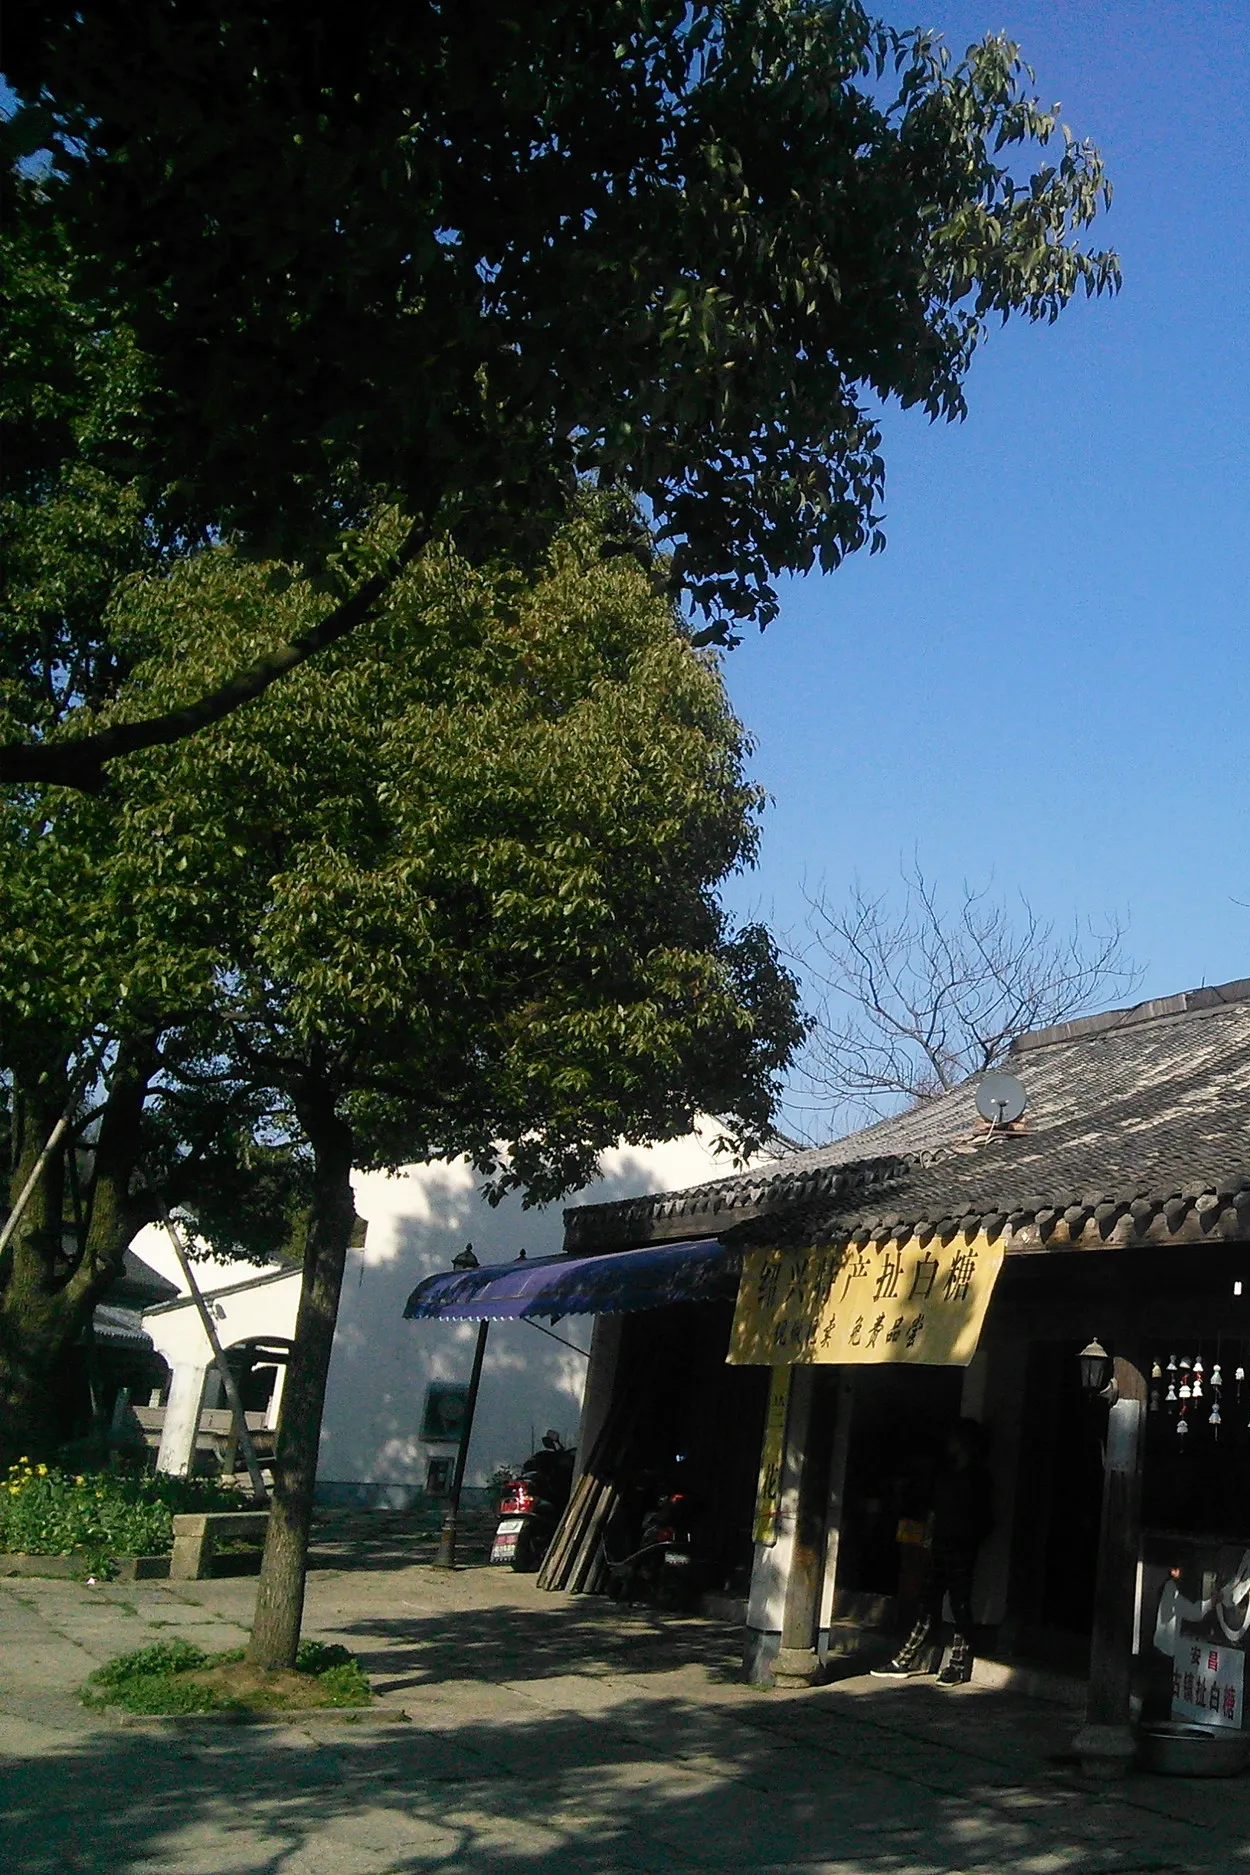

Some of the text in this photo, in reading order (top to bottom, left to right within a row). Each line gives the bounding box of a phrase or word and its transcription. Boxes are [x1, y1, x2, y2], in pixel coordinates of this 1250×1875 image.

[757, 1248, 980, 1307] 绍兴特产扯白糖
[847, 1311, 924, 1349] 免费品尝
